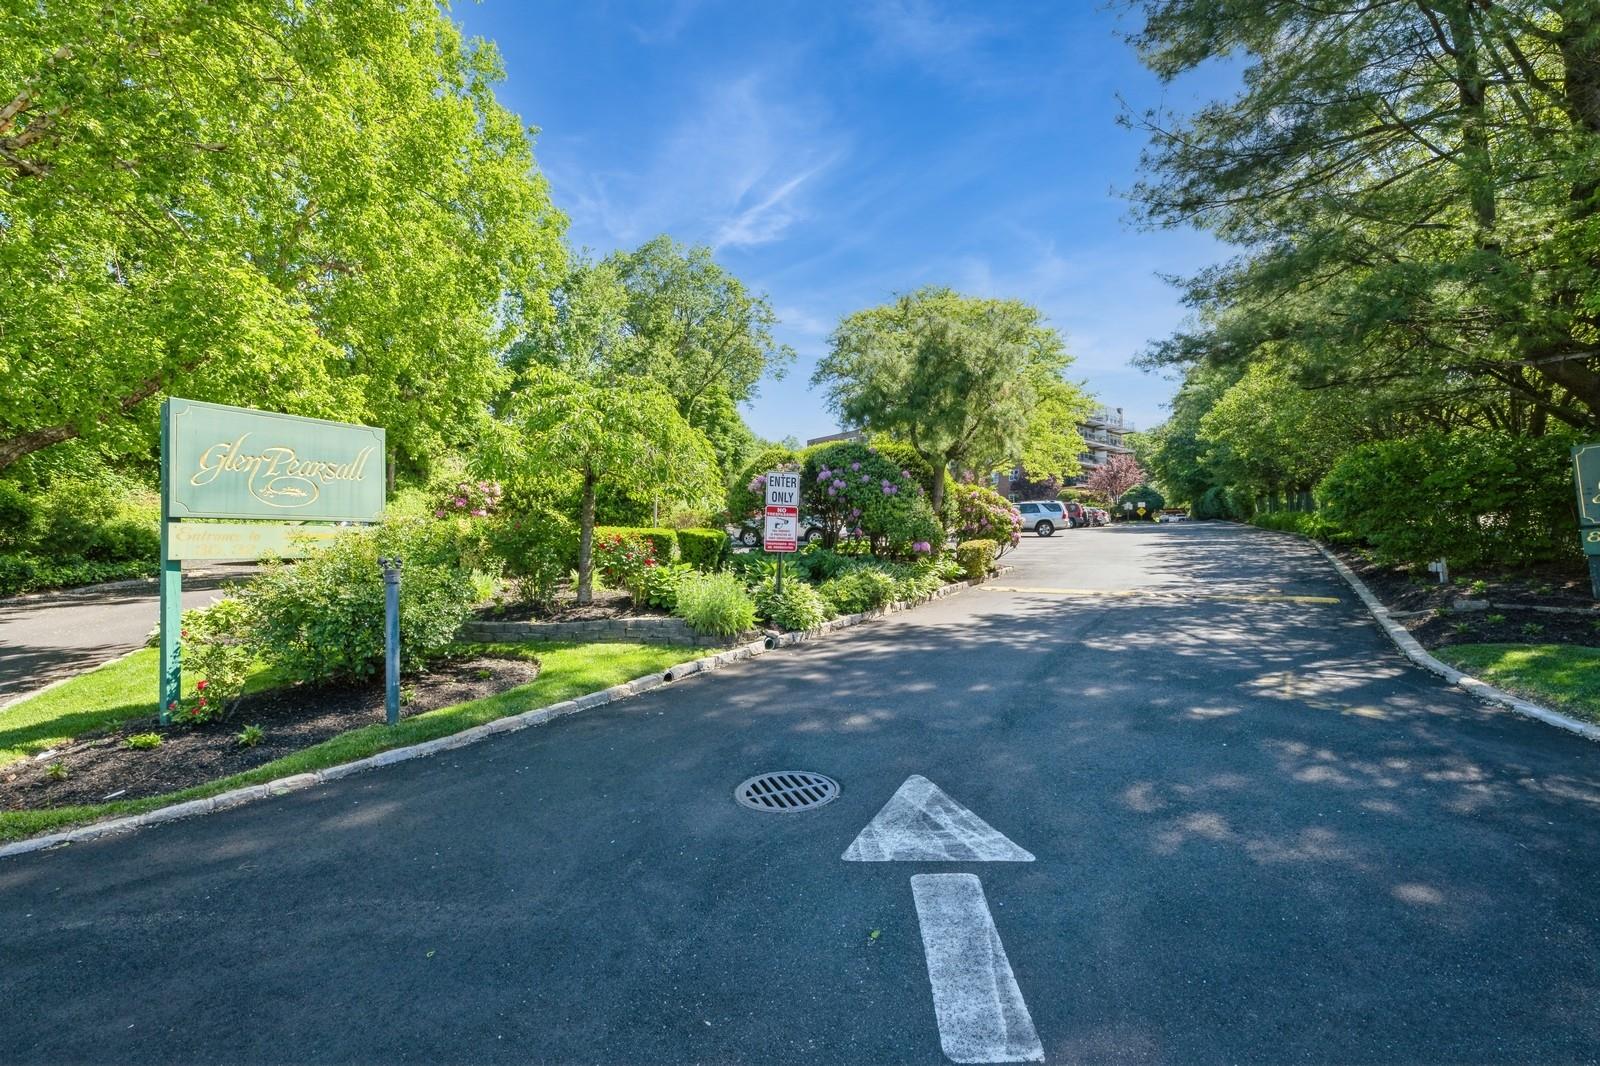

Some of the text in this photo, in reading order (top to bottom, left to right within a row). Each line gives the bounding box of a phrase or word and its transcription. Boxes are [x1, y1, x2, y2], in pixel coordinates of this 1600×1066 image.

[190, 432, 377, 486] Glen Pearsall
[770, 476, 796, 488] ENTER
[772, 492, 794, 502] ONLY
